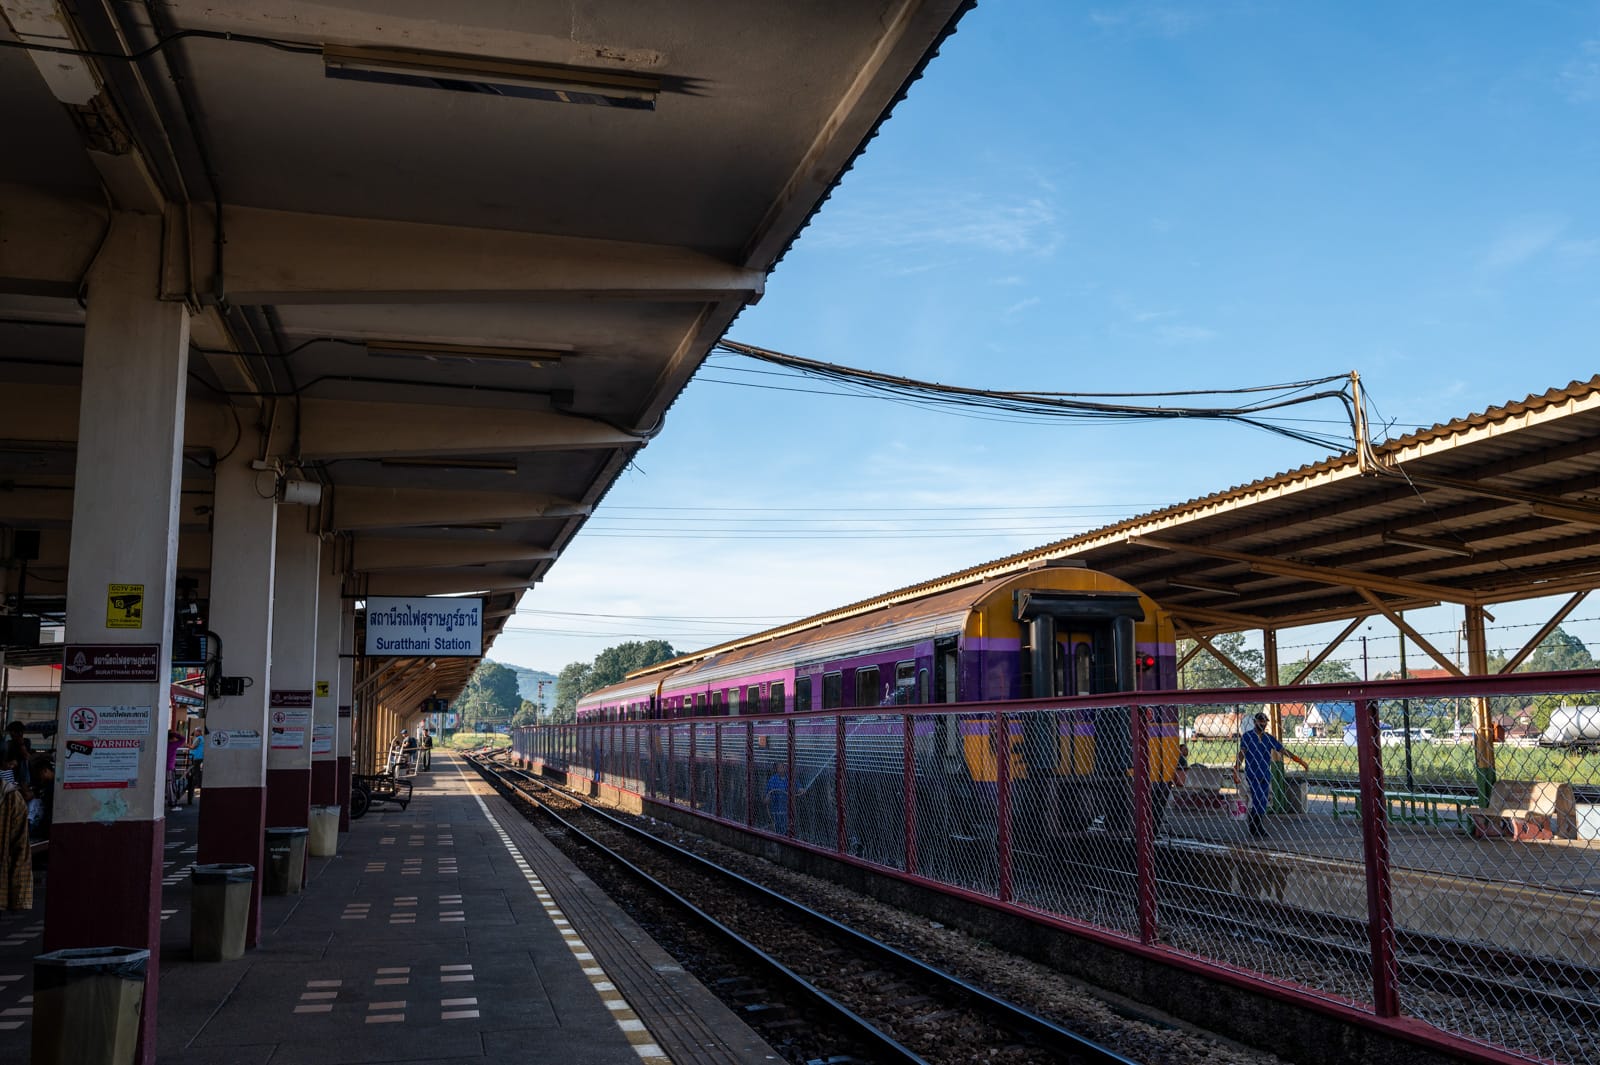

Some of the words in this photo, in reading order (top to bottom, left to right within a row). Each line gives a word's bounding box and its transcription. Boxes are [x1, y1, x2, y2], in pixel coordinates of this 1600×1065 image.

[370, 604, 478, 632] สถานีรถไฟสุราษฎร์ธานี
[376, 637, 430, 650] Suratthani
[434, 637, 471, 650] Station
[70, 743, 88, 751] CCTV
